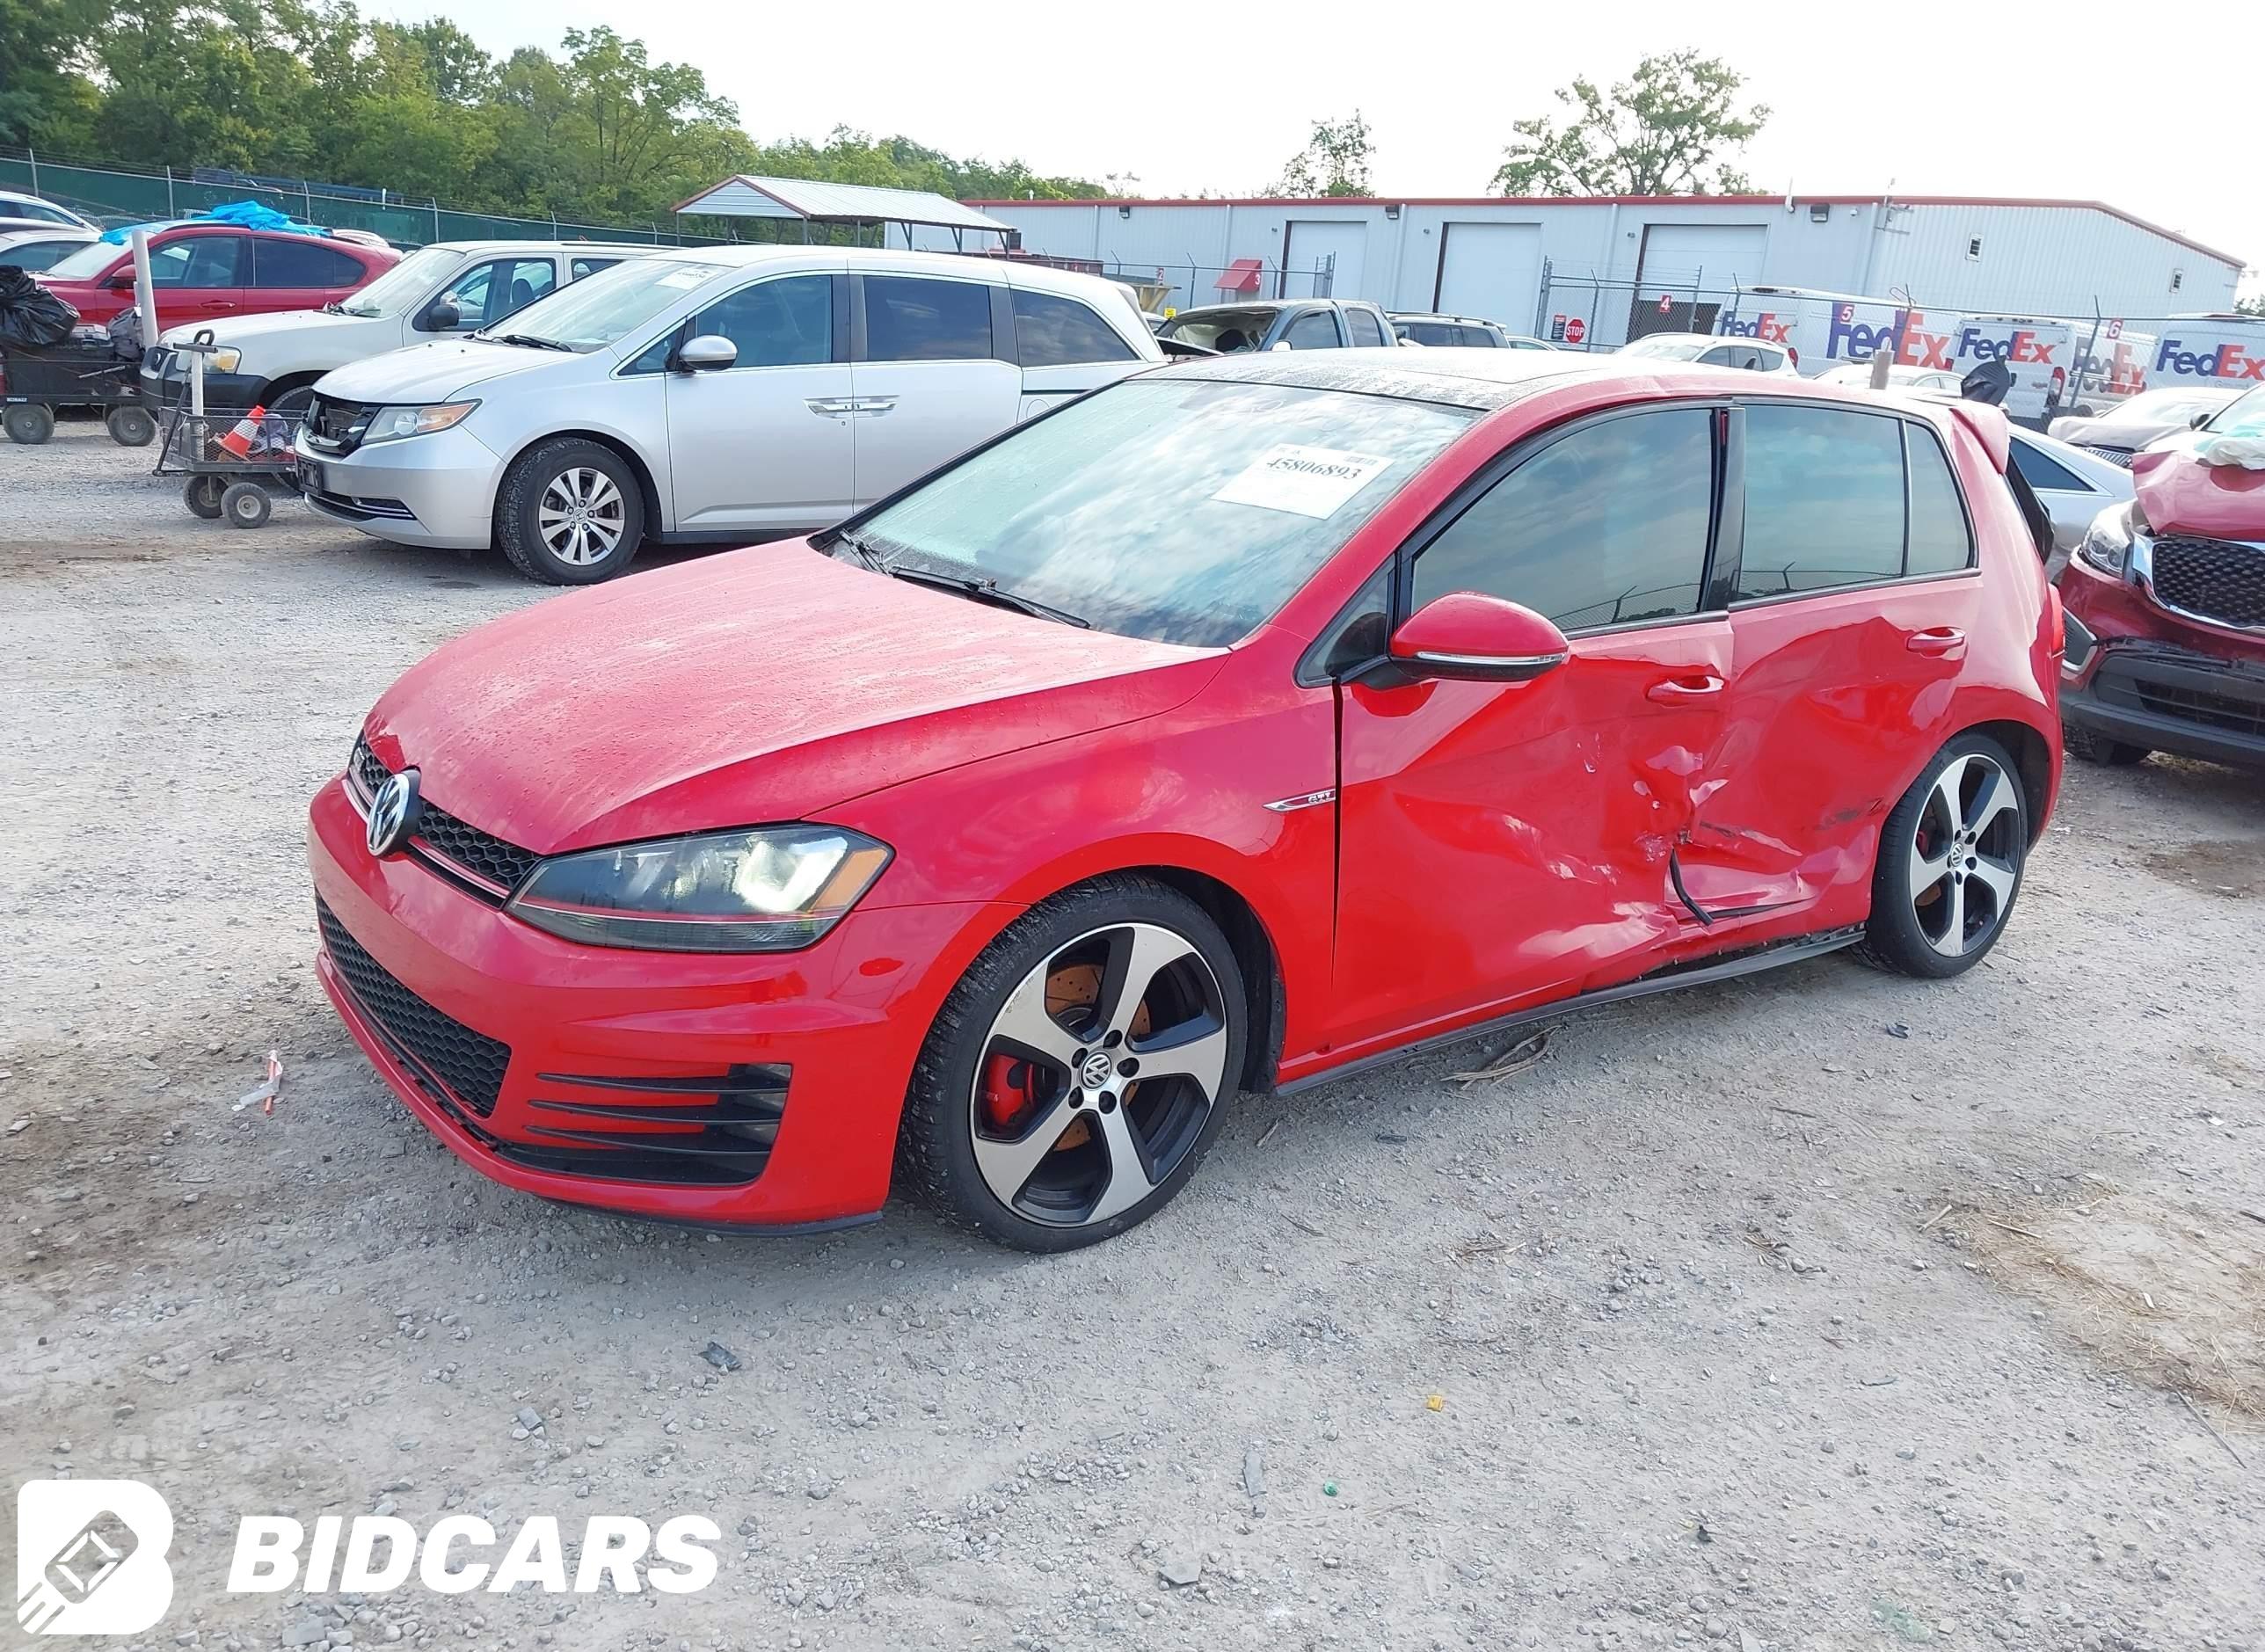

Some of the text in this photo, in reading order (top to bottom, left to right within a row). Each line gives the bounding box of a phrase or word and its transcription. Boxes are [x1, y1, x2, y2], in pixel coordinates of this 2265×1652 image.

[1158, 269, 1164, 280] 2
[1255, 273, 1261, 285] 3
[1661, 297, 1671, 310] 4
[1841, 306, 1853, 322] 5
[1567, 325, 1584, 337] STOP
[1721, 311, 1792, 344] FedEx
[1826, 302, 1950, 371] FedEx
[2108, 320, 2121, 338] 6
[1958, 328, 2056, 365] FedEx
[2069, 337, 2147, 393] FedEx
[2156, 339, 2265, 381] FedEx
[1267, 457, 1362, 480] 45806893
